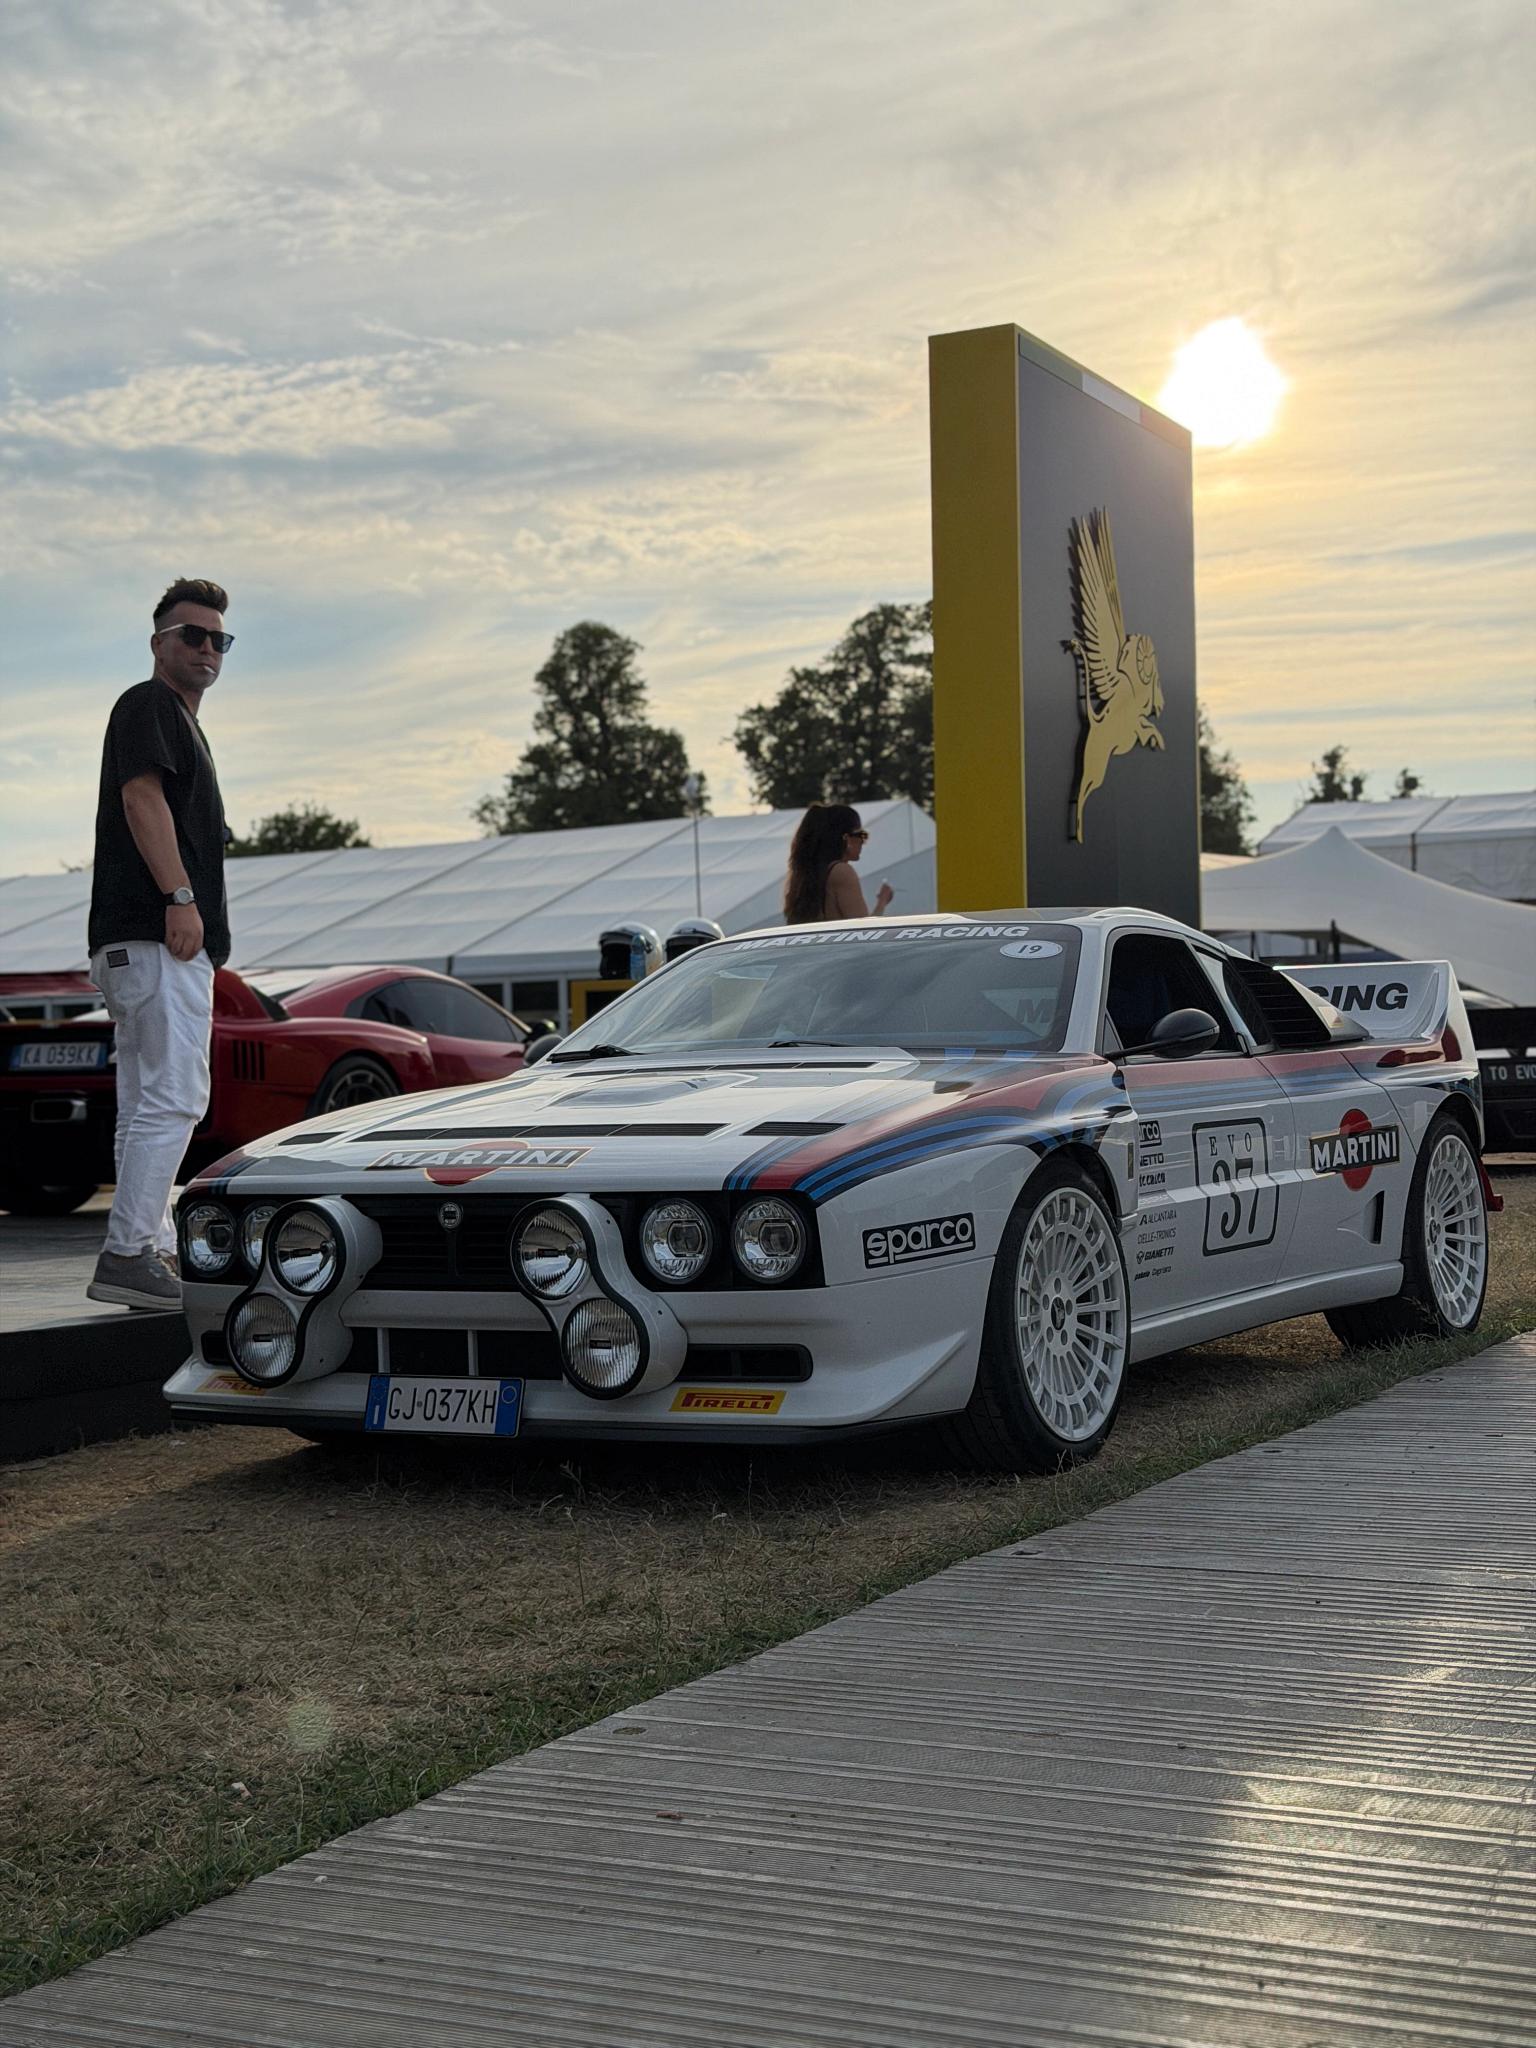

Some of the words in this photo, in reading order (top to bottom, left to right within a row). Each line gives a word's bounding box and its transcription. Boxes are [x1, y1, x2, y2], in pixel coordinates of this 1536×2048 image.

[734, 930, 888, 950] MARTINI
[895, 925, 1030, 940] RACING
[1017, 944, 1042, 955] 19
[1488, 1065, 1508, 1080] TO
[1208, 1132, 1253, 1157] EVO
[1312, 1130, 1398, 1172] MARTINI
[379, 1149, 581, 1166] MARTINI
[1212, 1156, 1259, 1239] 37
[866, 1217, 972, 1264] sparco
[681, 1392, 775, 1410] PIRELLI
